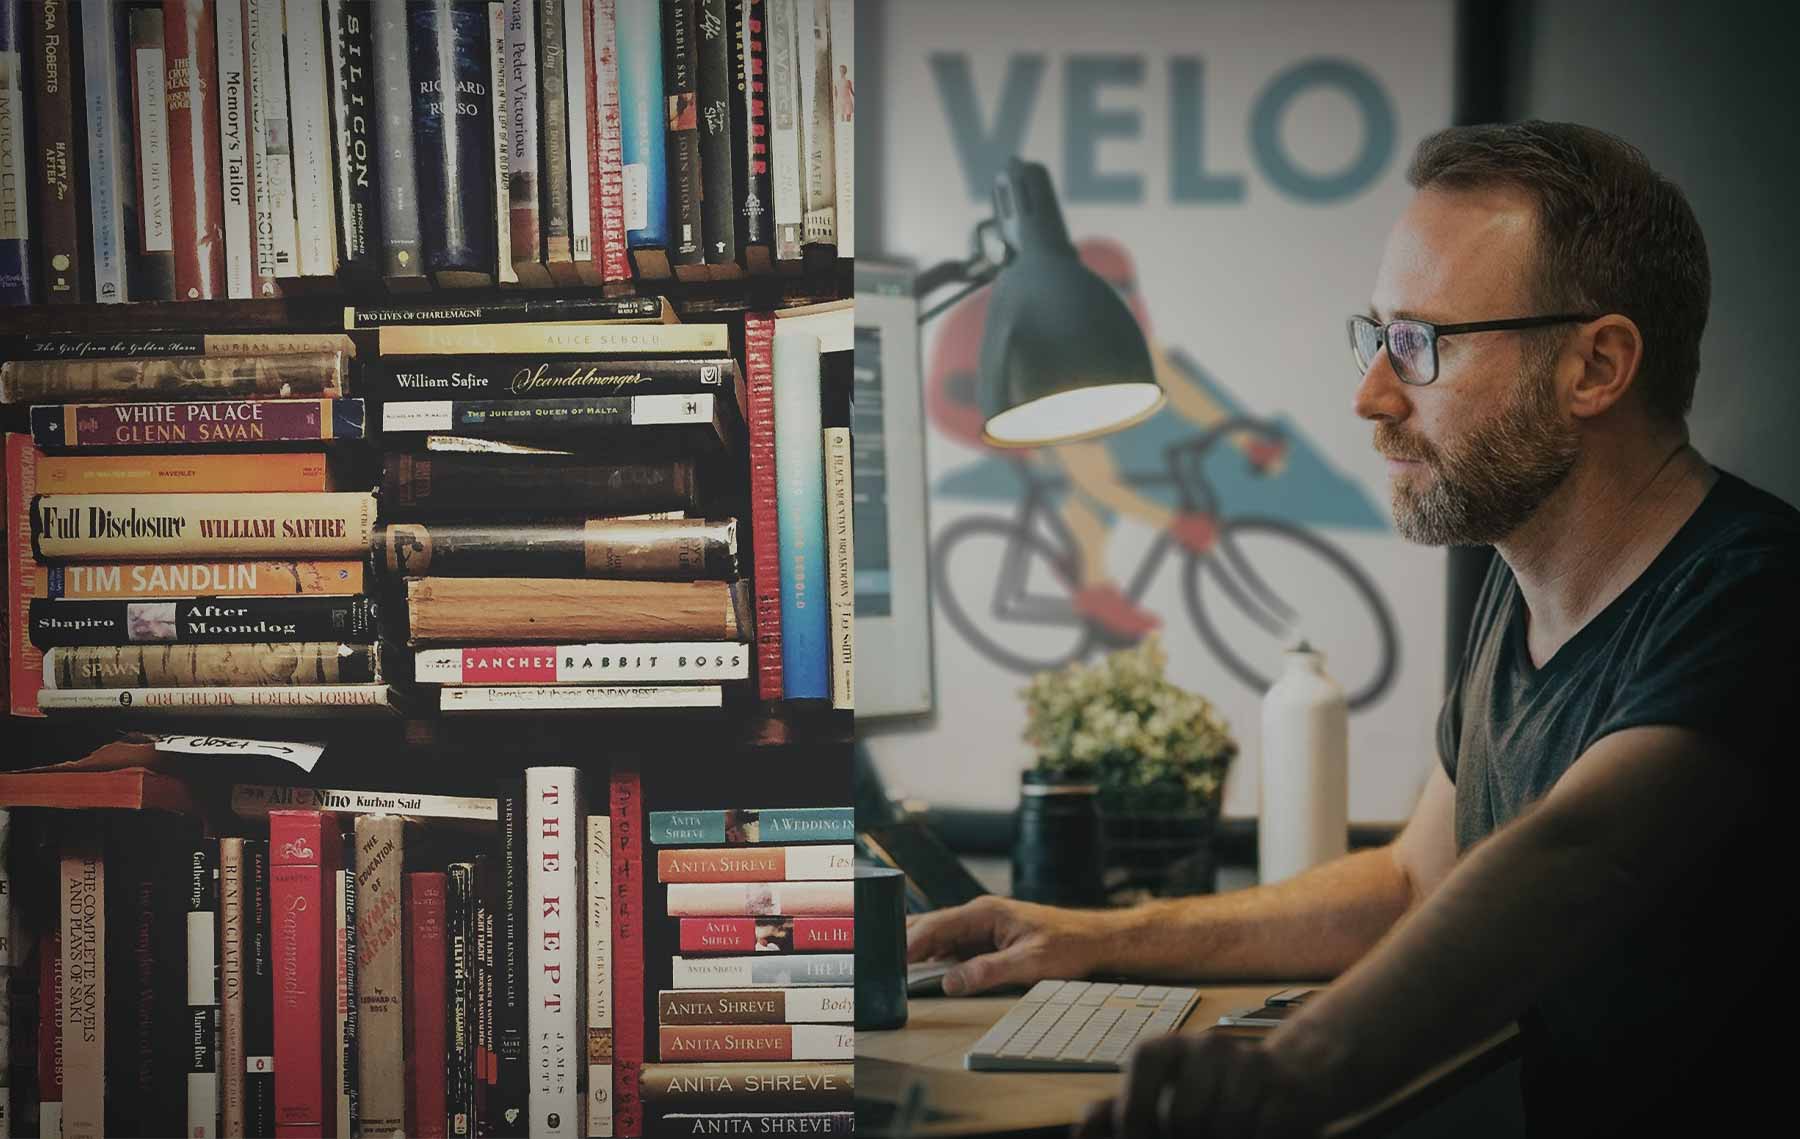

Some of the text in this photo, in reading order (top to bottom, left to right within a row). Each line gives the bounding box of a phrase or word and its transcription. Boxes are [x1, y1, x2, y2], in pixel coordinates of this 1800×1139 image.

[46, 34, 60, 94] ROBERTS
[734, 21, 746, 91] SHAPIRO
[676, 63, 687, 88] SKY
[420, 80, 485, 96] RICARD
[750, 19, 767, 175] REMEMBER
[347, 15, 368, 188] SILICON
[512, 42, 528, 158] Peder Victorious
[225, 71, 241, 158] Memory's
[928, 50, 1397, 205] VELO
[54, 142, 67, 178] HAPPY
[680, 136, 690, 171] JOHN
[46, 149, 58, 185] AFTER
[810, 151, 823, 197] WATER
[229, 156, 244, 205] Tailor
[807, 215, 832, 225] LITTLE
[357, 309, 481, 321] TWO LIVES OF CHARLEMAGNE
[34, 343, 56, 352] The
[110, 343, 127, 352] the
[213, 343, 270, 351] KURBAN
[278, 342, 311, 351] SAID
[547, 336, 590, 345] ALICE
[396, 363, 653, 395] William Safire Scandalmonger
[115, 403, 263, 423] WHITE PALACE
[467, 410, 485, 418] THE
[490, 409, 531, 417] JUKEBOX
[535, 408, 567, 416] QUEEN
[587, 407, 618, 415] MALTA
[116, 423, 264, 442] GLENN SAVAN
[42, 506, 80, 539] Full
[88, 505, 186, 539] Disclosure
[199, 518, 276, 538] WILLIAM
[282, 518, 346, 539] SAFIRE
[69, 567, 121, 593] TIM
[131, 564, 257, 593] SANDLIN
[187, 606, 249, 617] After
[39, 617, 115, 629] Shapiro
[189, 622, 297, 635] Moondog
[82, 662, 140, 678] SPAWN
[466, 656, 740, 669] SANCHEZ RABBIT BOSS
[312, 791, 351, 808] Nino
[356, 795, 395, 809] Kurban
[397, 797, 421, 810] Said
[671, 816, 702, 825] ANITA
[770, 819, 780, 831] A
[782, 818, 840, 830] WEDDING
[363, 834, 379, 854] THE
[665, 830, 704, 838] SHREVE
[358, 839, 394, 888] EDUCATION
[669, 857, 777, 873] ANITA SHREVE
[192, 851, 206, 908] Gatherings
[371, 877, 383, 892] OF
[345, 868, 358, 912] Justine
[542, 785, 561, 1013] THE KEPT
[225, 865, 239, 1000] RENUNCIATION
[706, 922, 737, 932] ANITA
[807, 927, 848, 941] ALL HE
[702, 936, 740, 945] SHREVE
[70, 878, 82, 1024] AND PLAYS OF SAKI
[83, 860, 96, 1042] THE COMPLETE NOVELS
[454, 936, 464, 979] LILITH
[807, 962, 832, 976] THE
[666, 999, 775, 1015] ANITA SHREVE
[193, 1009, 206, 1068] Marina Rust
[672, 1035, 783, 1050] ANITA SHREVE
[542, 1033, 551, 1094] SCOTT
[556, 1033, 565, 1094] JAMES
[666, 1075, 837, 1093] ANITA SHREVE
[692, 1118, 831, 1134] ANITA SHREVE
